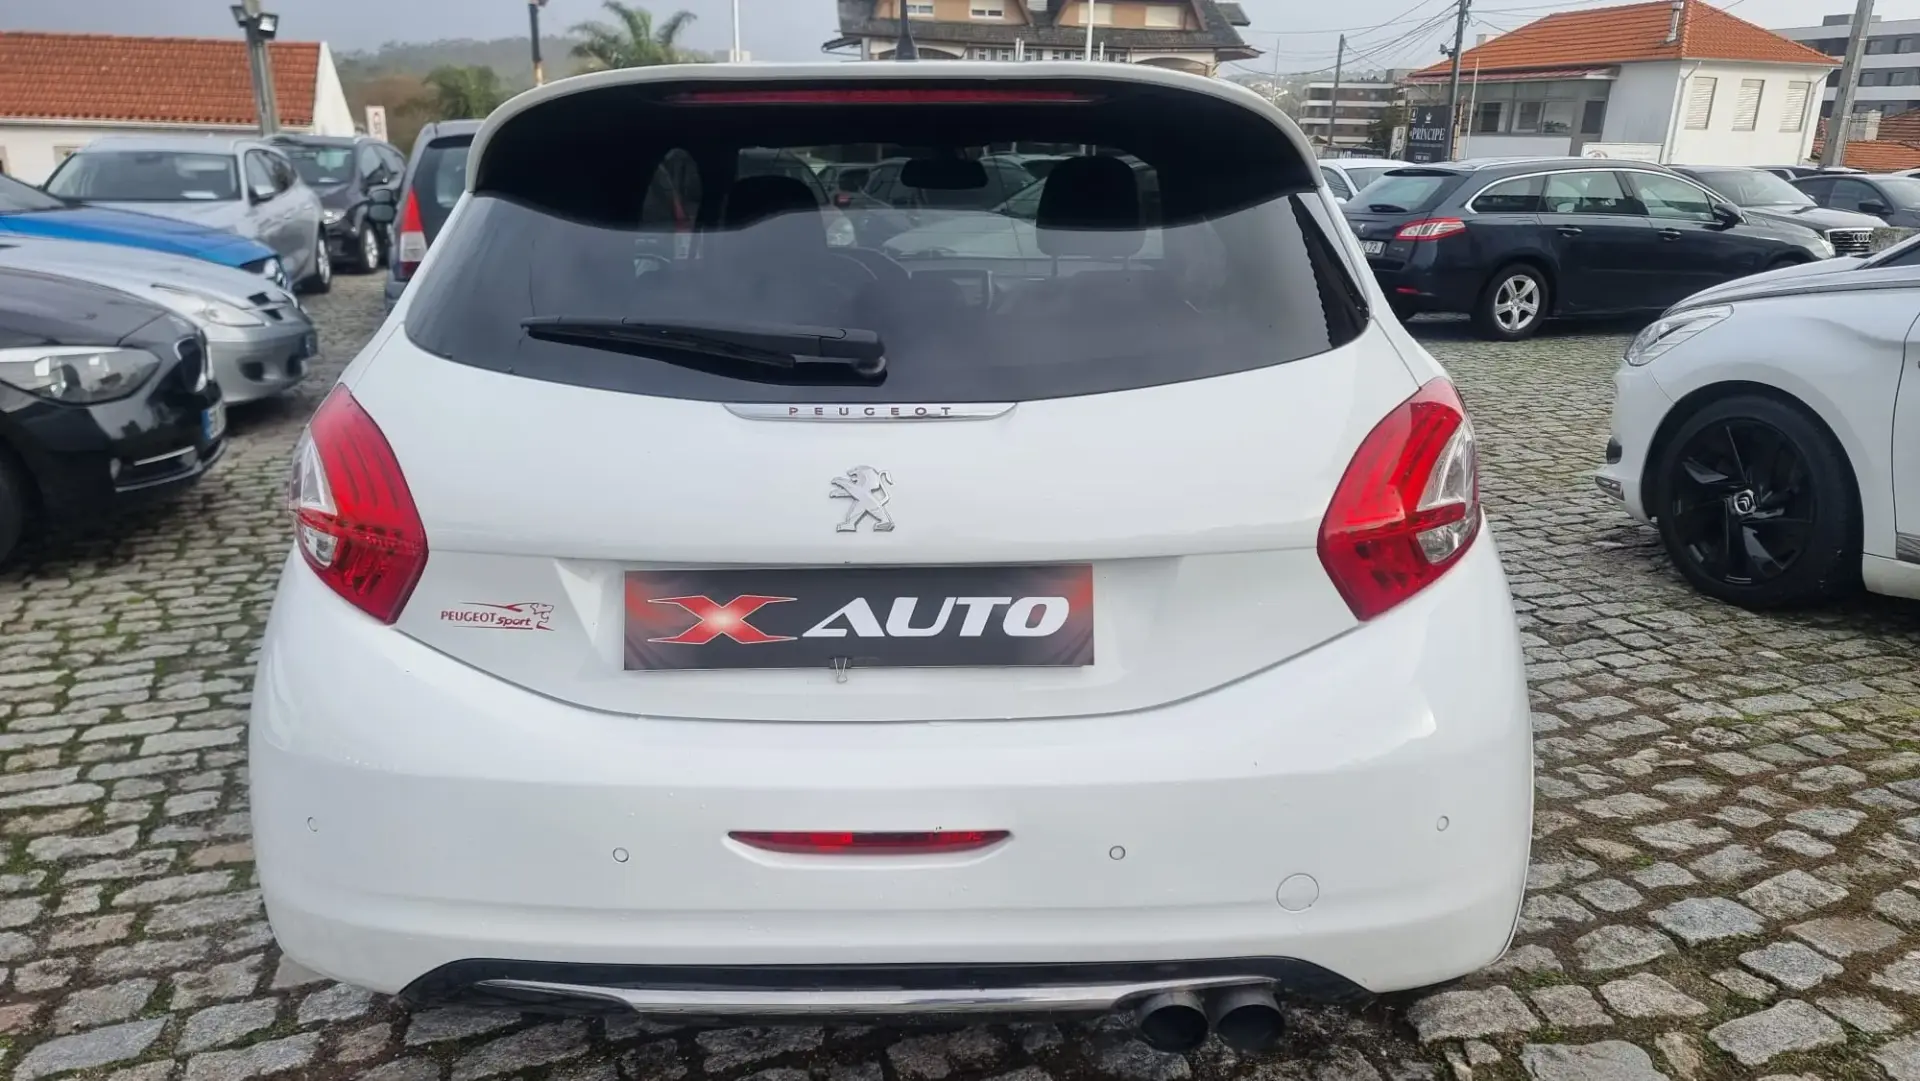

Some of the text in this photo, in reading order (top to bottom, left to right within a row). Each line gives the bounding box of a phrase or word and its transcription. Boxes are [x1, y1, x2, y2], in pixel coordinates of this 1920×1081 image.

[788, 406, 951, 416] PEUGEOT
[440, 610, 497, 623] PEUGEOT
[647, 594, 1070, 645] X AUTO
